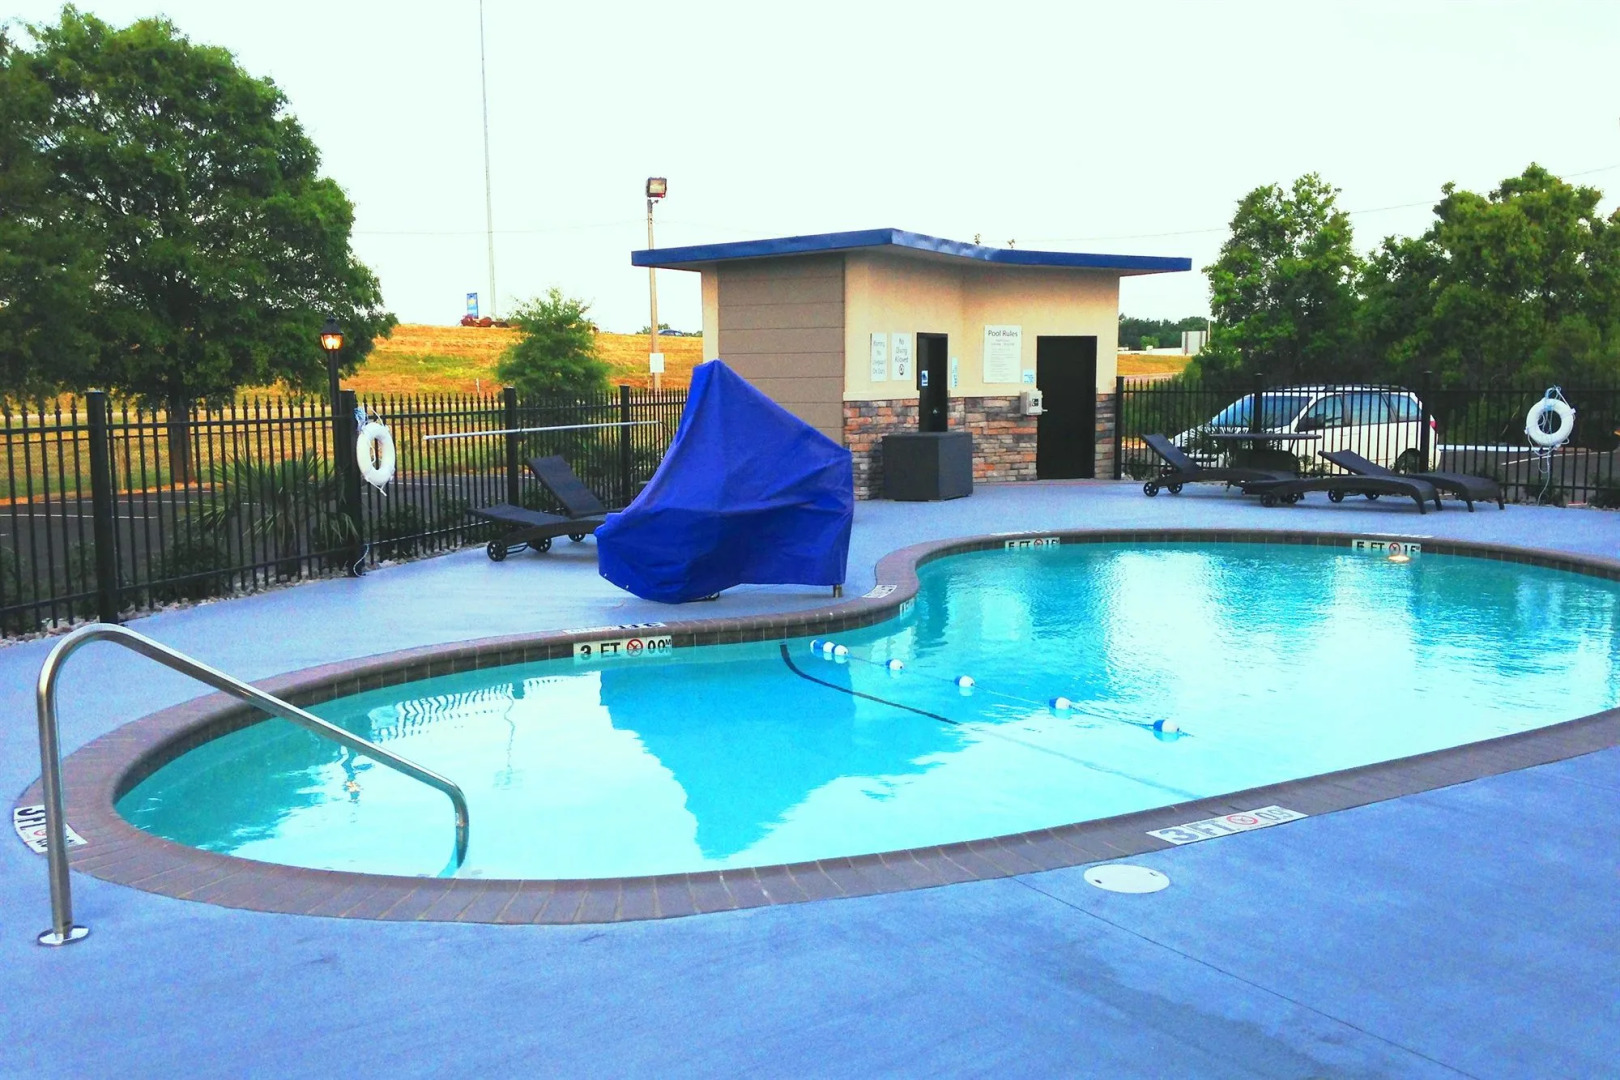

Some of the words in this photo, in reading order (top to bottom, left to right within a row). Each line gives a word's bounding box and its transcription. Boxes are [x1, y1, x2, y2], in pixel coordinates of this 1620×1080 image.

[988, 329, 1001, 337] Pool
[1002, 329, 1018, 337] Rules
[1159, 828, 1200, 842] 3
[1180, 818, 1238, 837] FT
